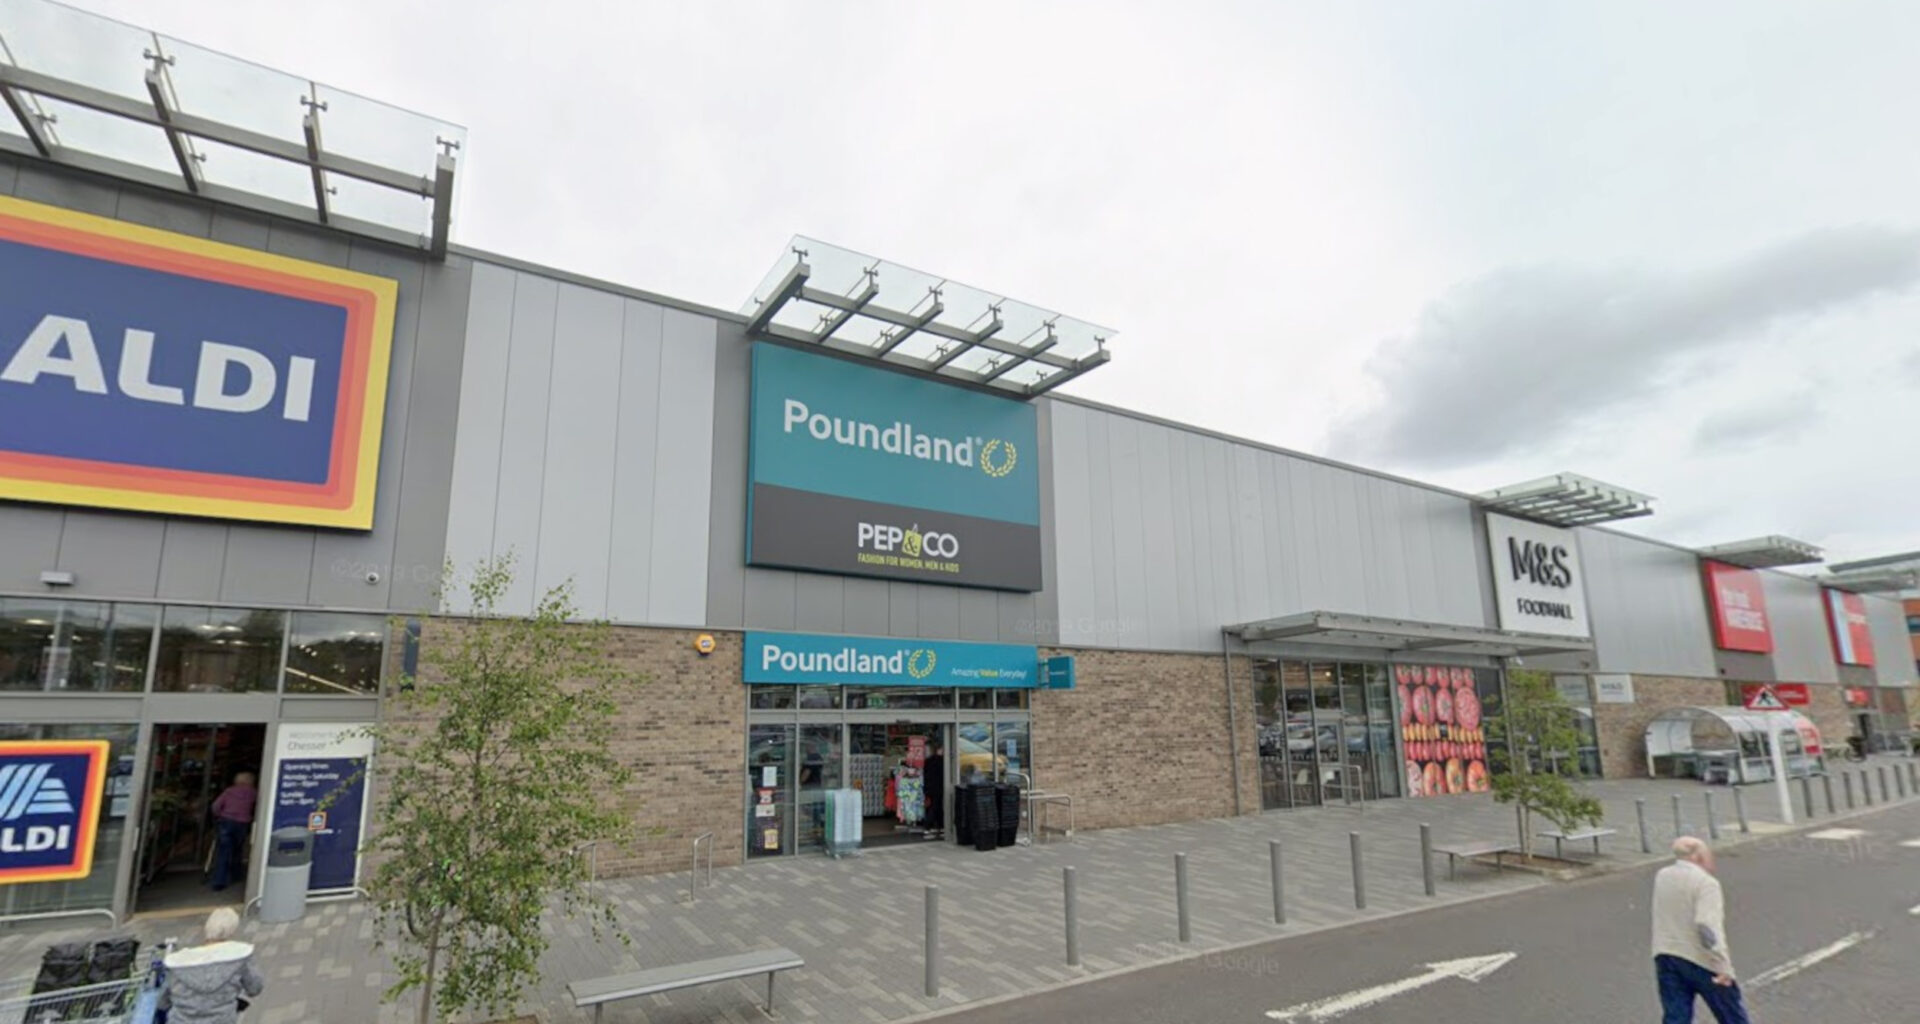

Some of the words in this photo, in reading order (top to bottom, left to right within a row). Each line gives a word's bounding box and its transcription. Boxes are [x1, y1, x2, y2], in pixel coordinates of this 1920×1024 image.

[0, 314, 316, 422] ALDI
[784, 399, 973, 467] Poundland
[858, 553, 885, 565] FASHION
[886, 556, 898, 566] FOR
[925, 561, 938, 570] MEN
[945, 563, 959, 573] KIDS
[1508, 536, 1572, 589] M&S
[1517, 597, 1574, 620] FOODHALL
[762, 644, 903, 674] Poundland
[1, 825, 71, 853] LDI
